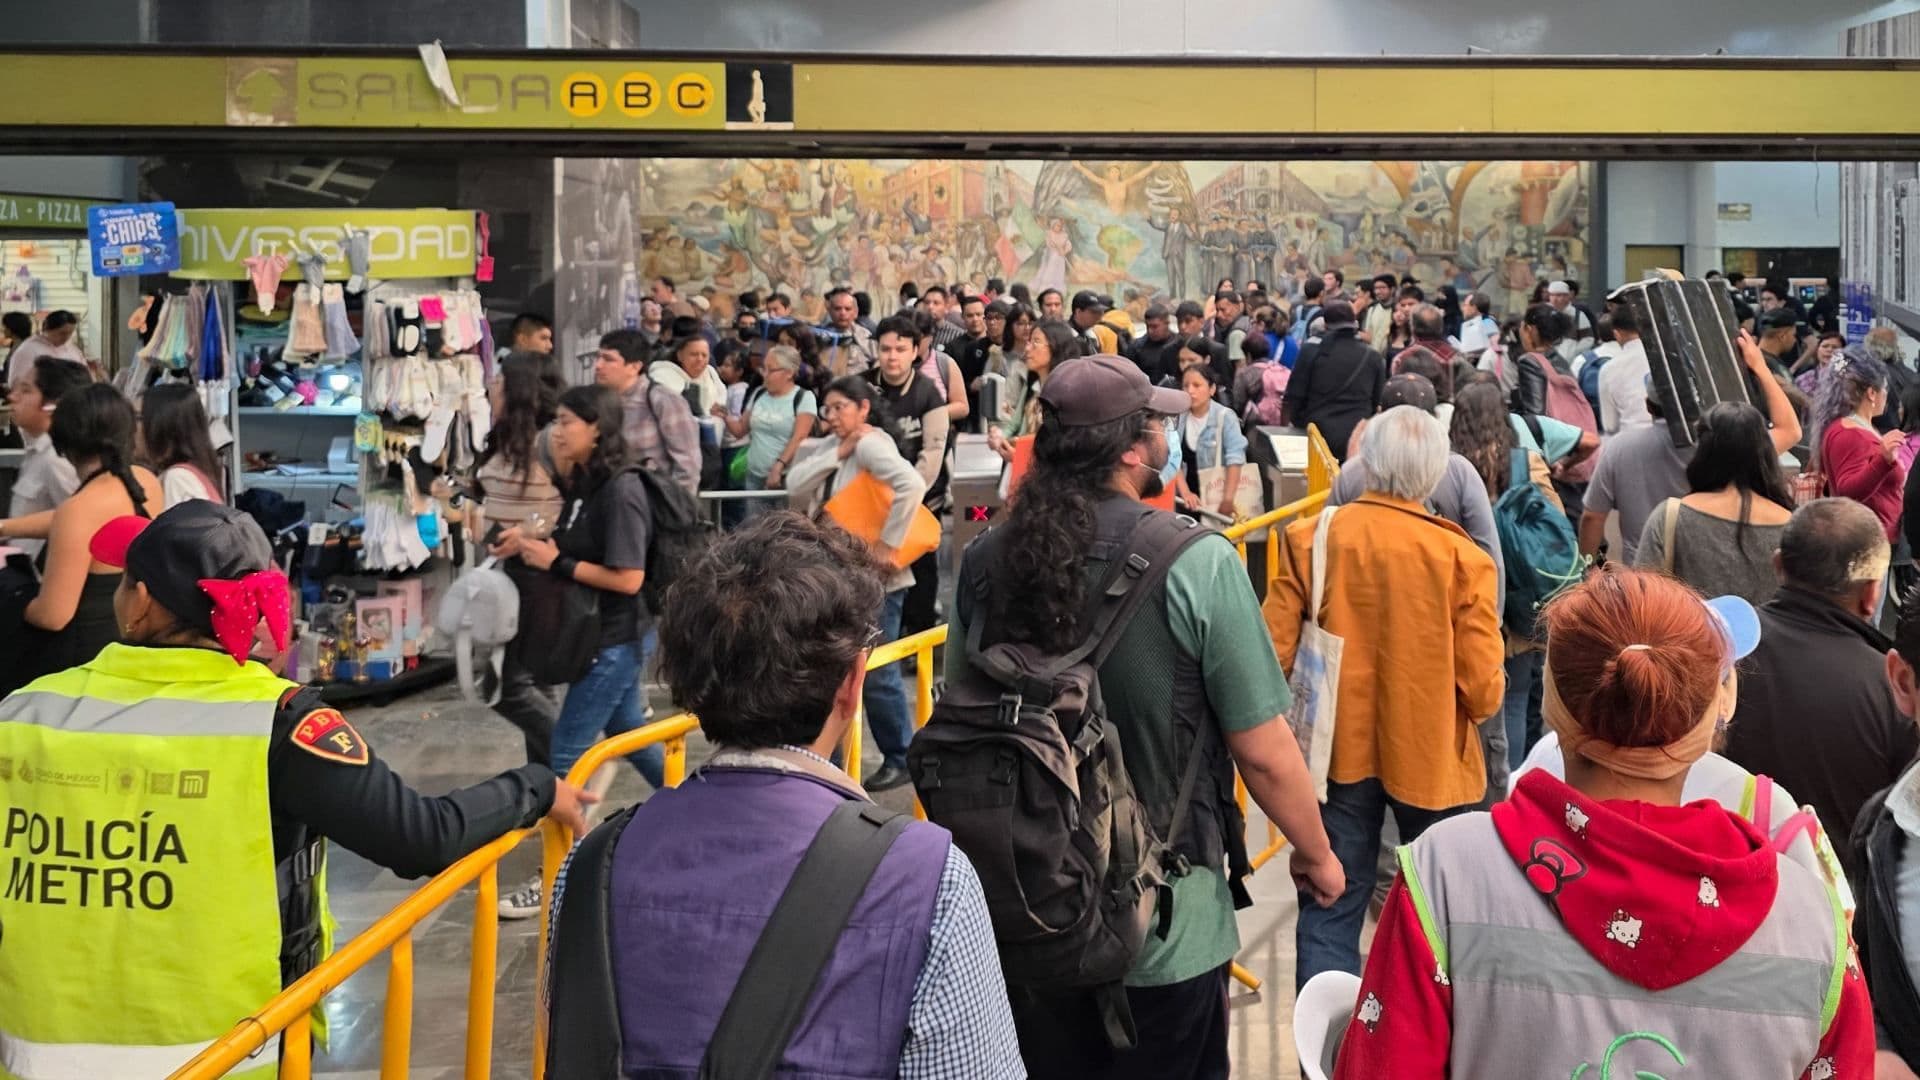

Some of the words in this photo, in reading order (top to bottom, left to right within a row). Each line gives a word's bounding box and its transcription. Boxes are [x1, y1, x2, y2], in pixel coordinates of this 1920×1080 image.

[570, 82, 597, 108] A
[624, 82, 651, 108] B
[678, 82, 705, 109] C
[38, 202, 82, 223] PIZZA
[106, 217, 162, 245] CHIPS
[3, 807, 189, 864] POLICÍA
[3, 856, 174, 911] METRO
